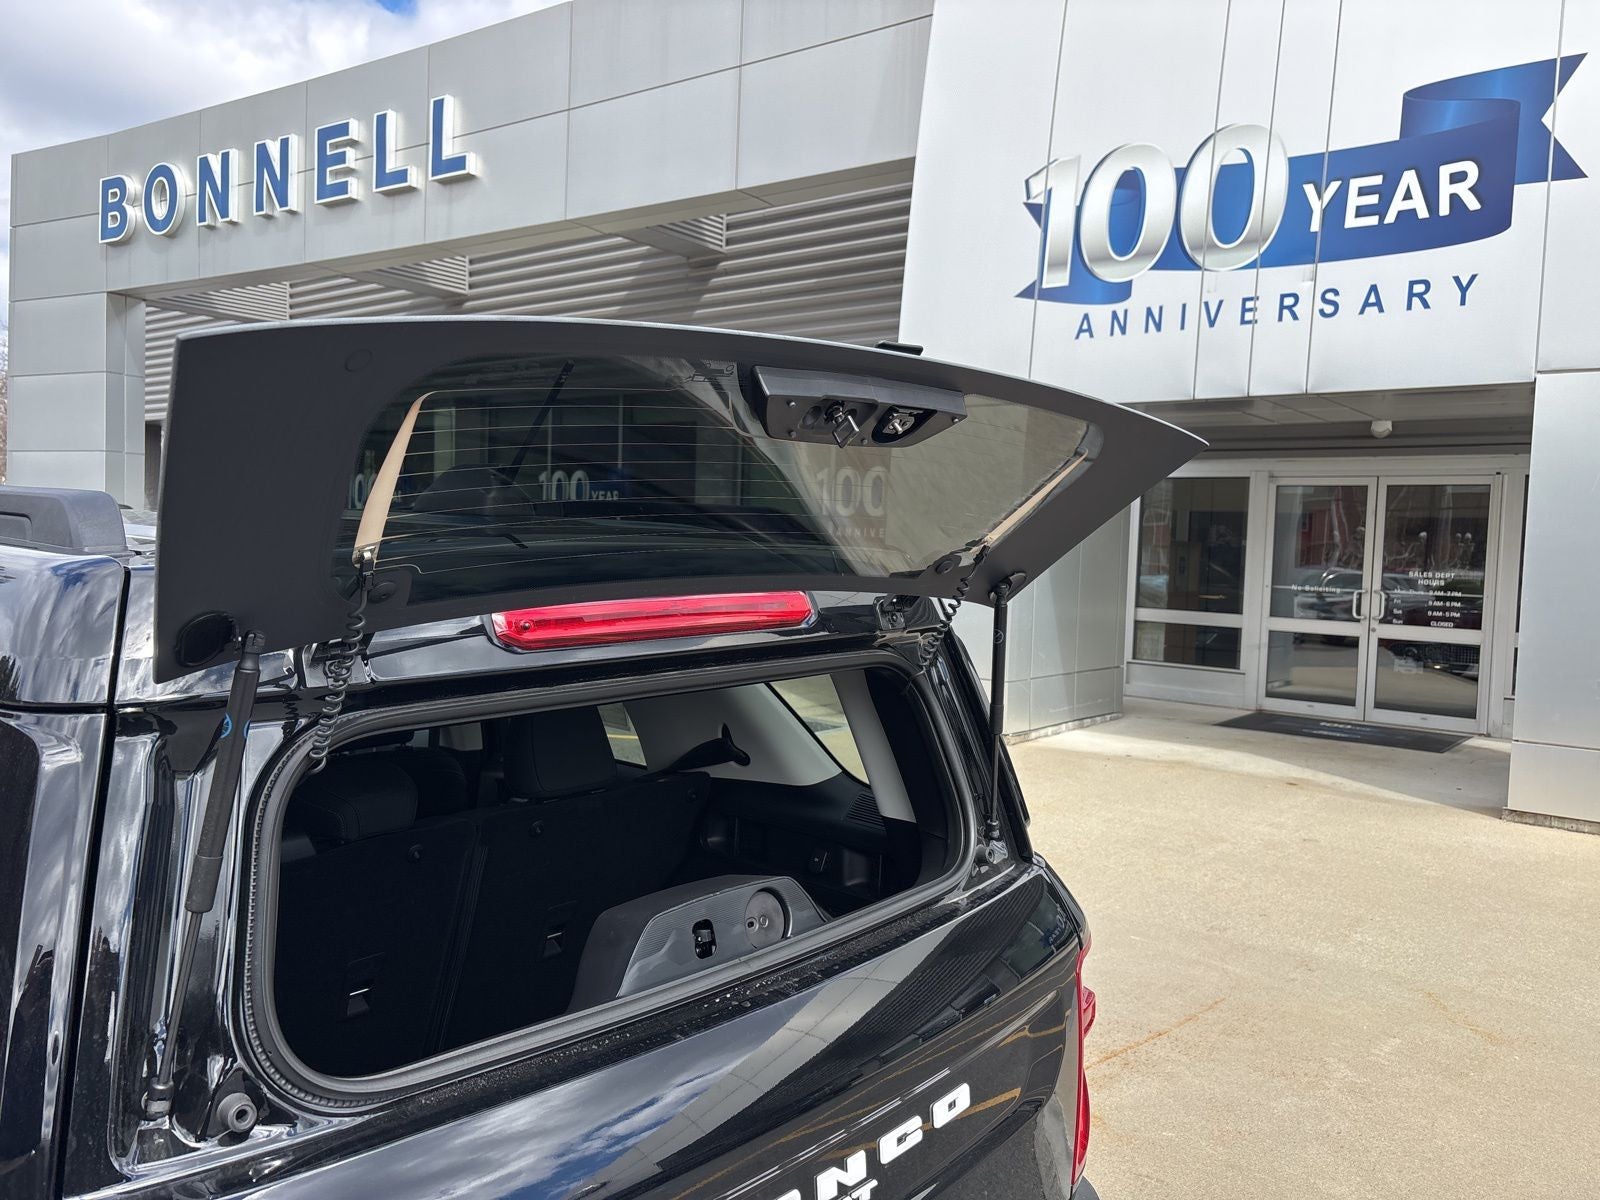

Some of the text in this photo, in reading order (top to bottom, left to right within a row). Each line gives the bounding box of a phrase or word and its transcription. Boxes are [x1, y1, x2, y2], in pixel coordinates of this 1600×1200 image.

[98, 94, 479, 244] BONNELL
[1024, 123, 1483, 289] 100 YEAR
[1074, 272, 1480, 340] ANNIVERSARY
